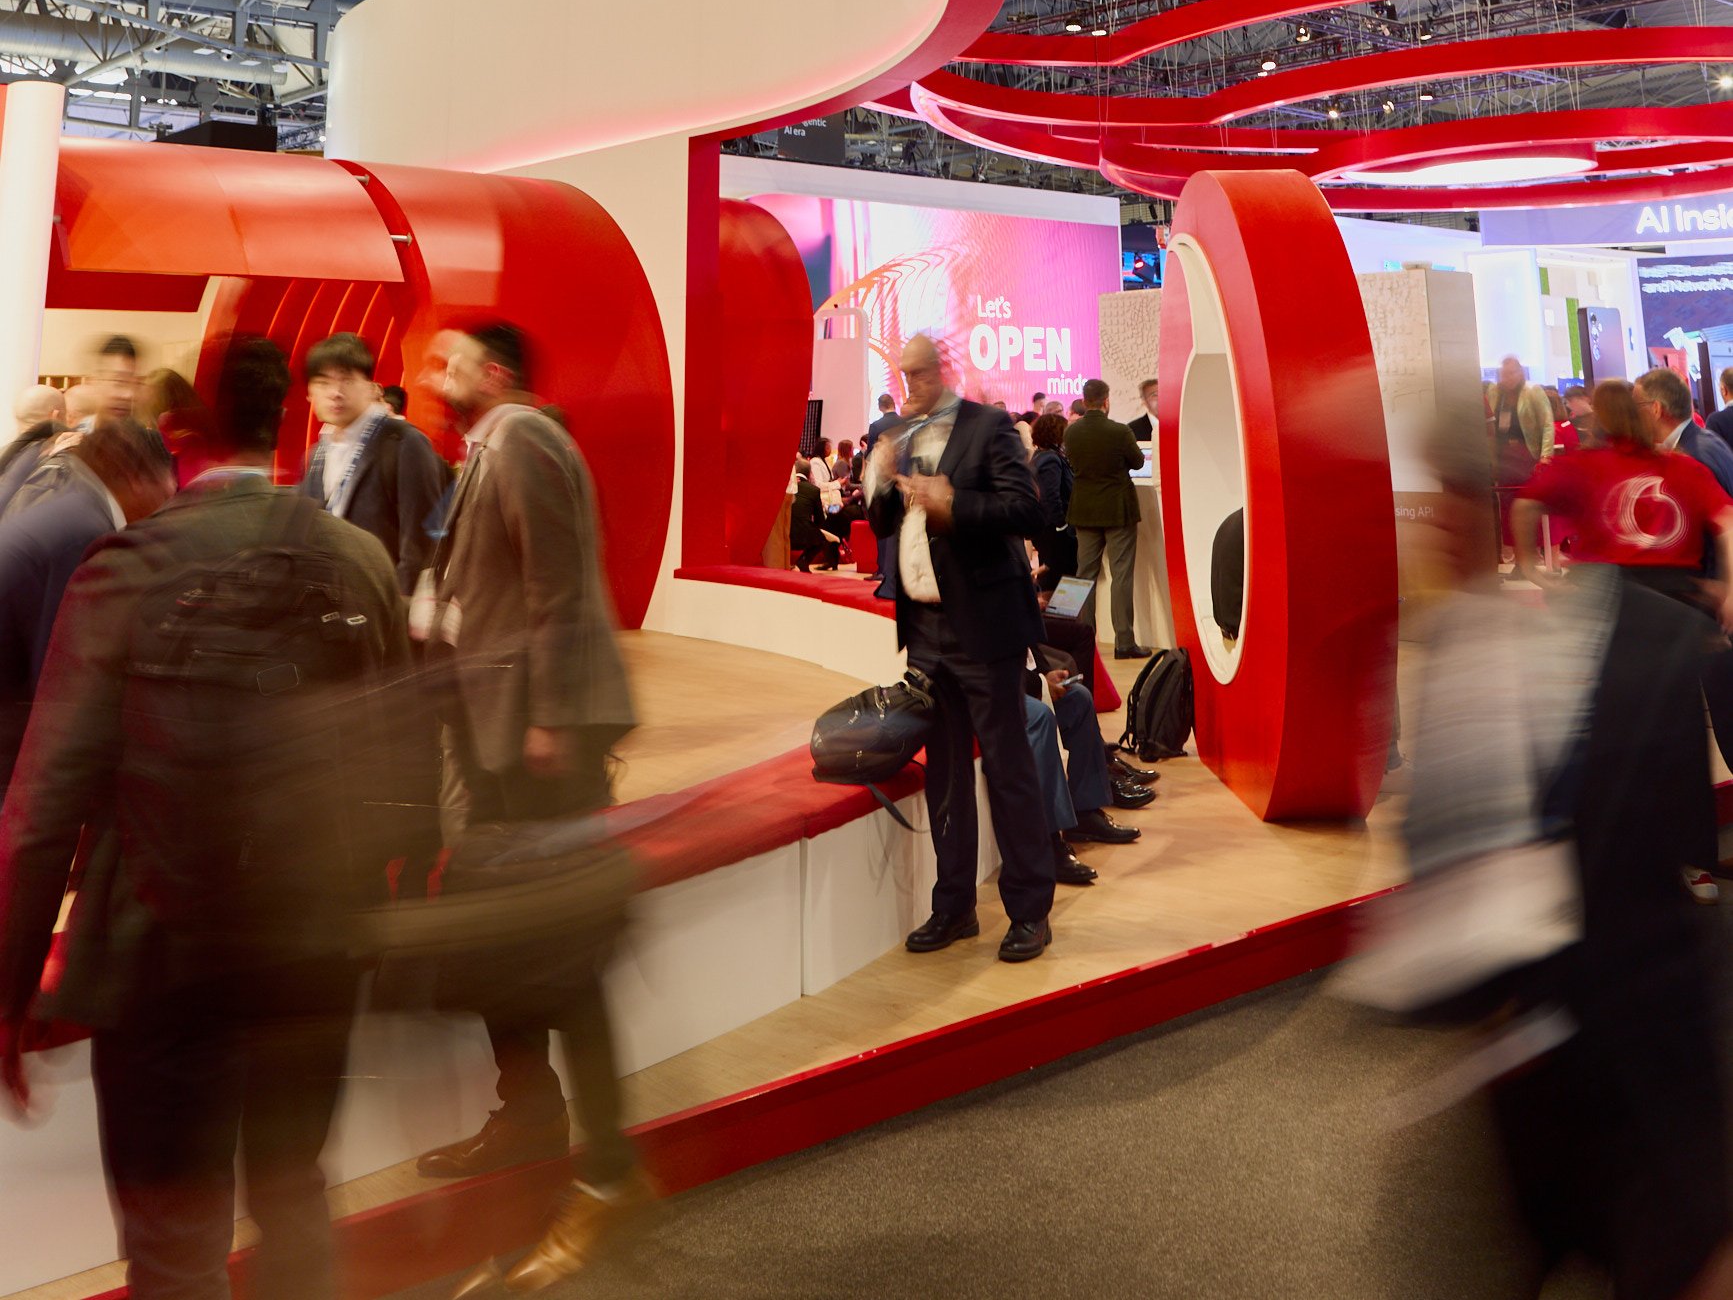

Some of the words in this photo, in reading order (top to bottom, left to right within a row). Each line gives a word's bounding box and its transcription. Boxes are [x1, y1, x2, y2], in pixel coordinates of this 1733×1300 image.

[793, 128, 806, 137] era
[1636, 205, 1670, 234] AI
[977, 295, 1011, 318] Let's
[969, 324, 1071, 371] OPEN
